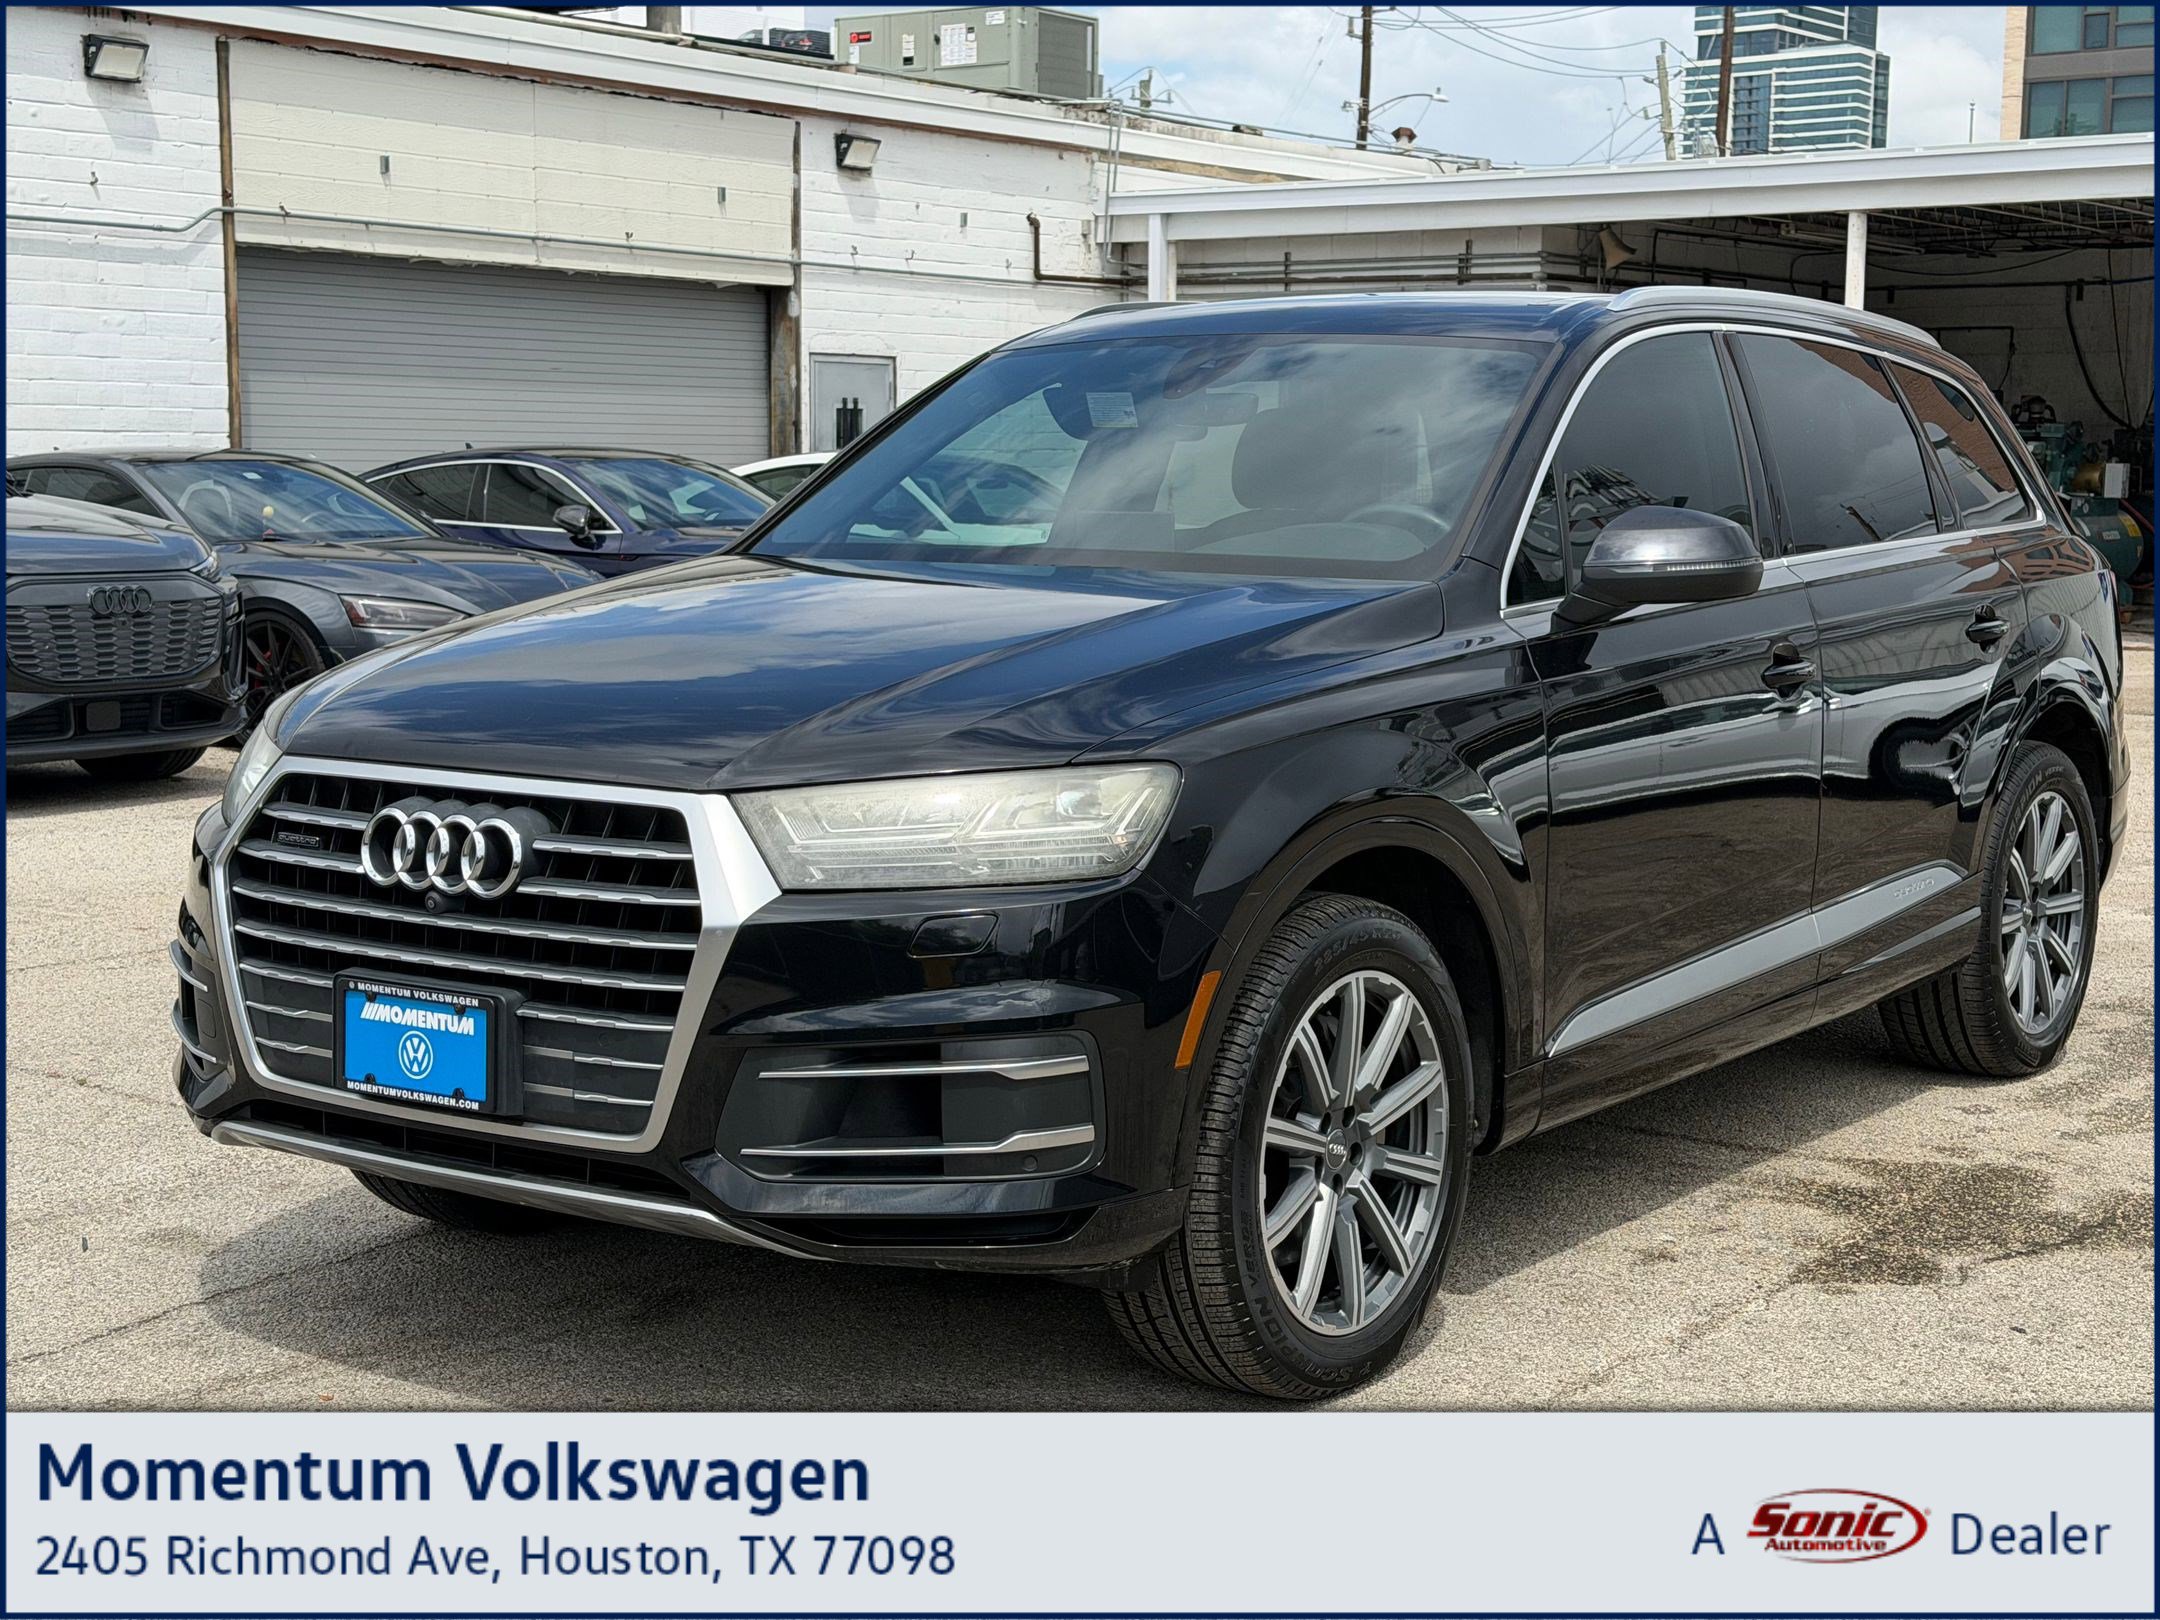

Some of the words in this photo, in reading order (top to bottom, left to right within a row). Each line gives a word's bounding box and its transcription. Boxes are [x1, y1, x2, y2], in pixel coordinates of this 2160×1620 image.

[278, 834, 317, 845] quattro
[358, 982, 411, 998] MOMENTUM
[413, 990, 479, 1007] VOLKSWAGEN
[374, 1006, 475, 1036] MOMENTUM
[347, 1081, 479, 1111] MOMENTUMVOLKSWAGEN.COM
